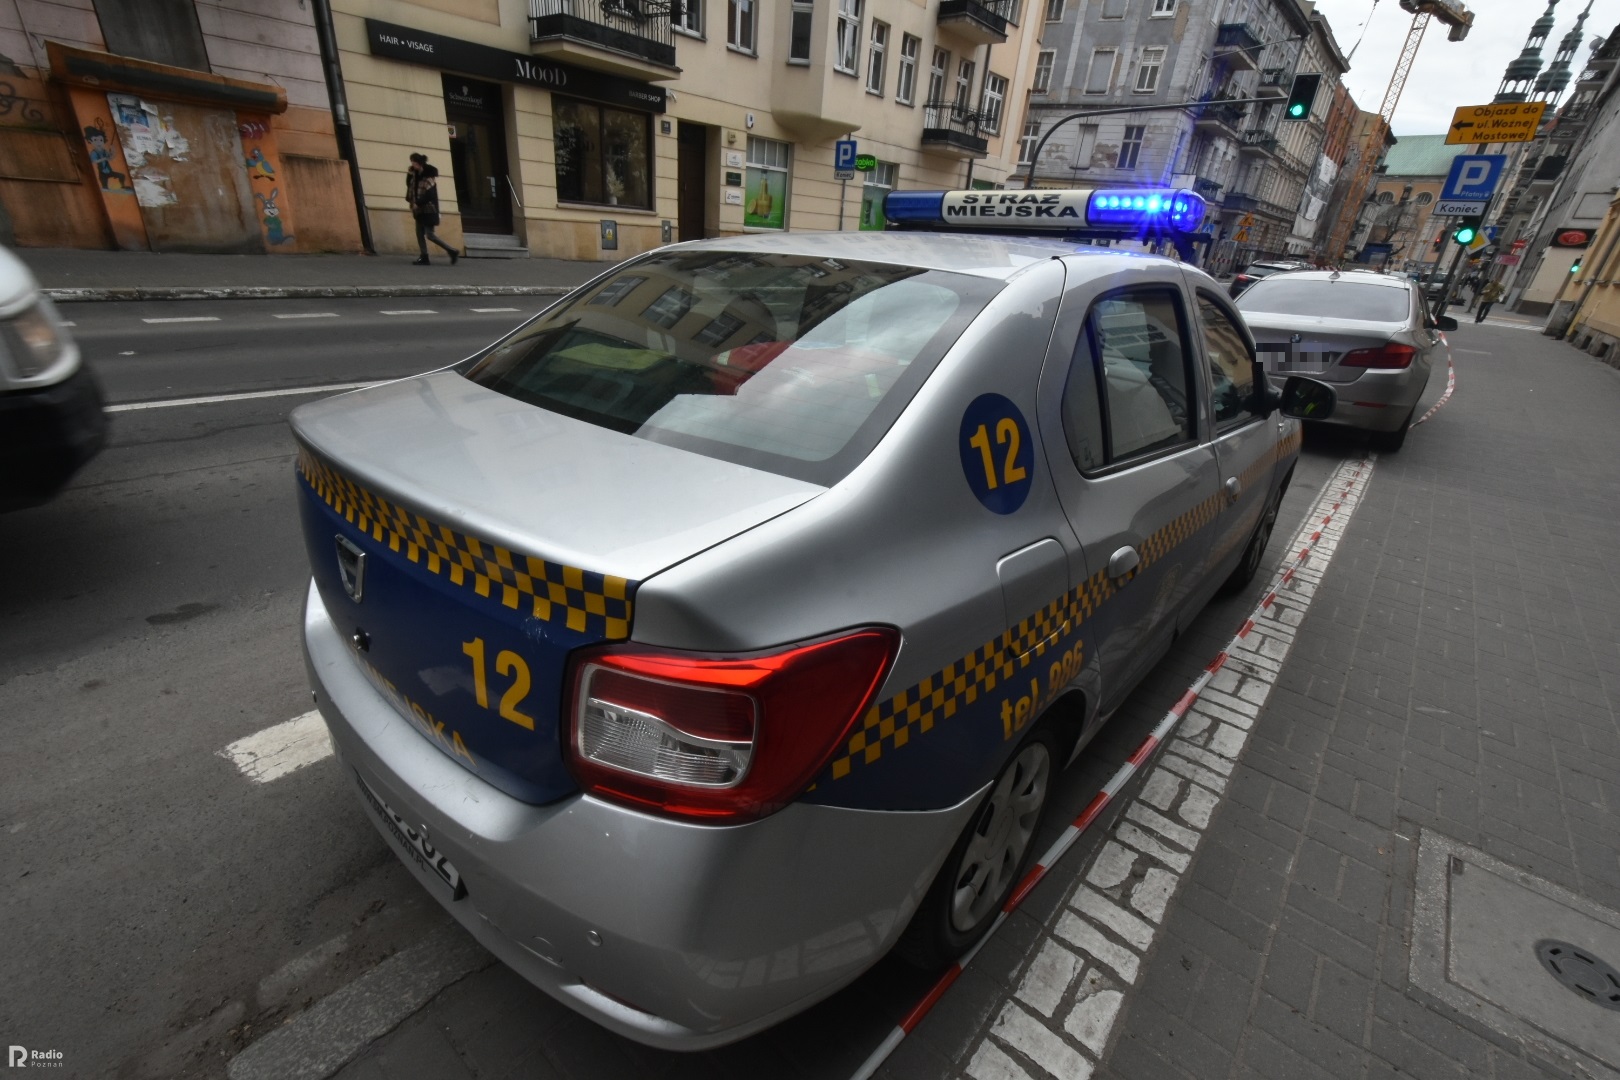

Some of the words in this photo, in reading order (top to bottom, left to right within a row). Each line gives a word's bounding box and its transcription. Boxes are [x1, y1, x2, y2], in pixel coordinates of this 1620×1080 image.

[379, 33, 399, 45] HAIR
[406, 40, 434, 53] VISAGE
[629, 90, 648, 100] BARBER
[648, 94, 661, 103] SHOP
[1474, 106, 1518, 118] Objazd
[1523, 105, 1539, 114] do
[1472, 130, 1529, 141] Mostowej
[839, 144, 852, 167] P
[1452, 160, 1491, 195] P
[947, 205, 1080, 218] MIEJSKA
[1439, 203, 1478, 214] Koniec
[969, 417, 1026, 490] 12
[462, 636, 535, 731] 12
